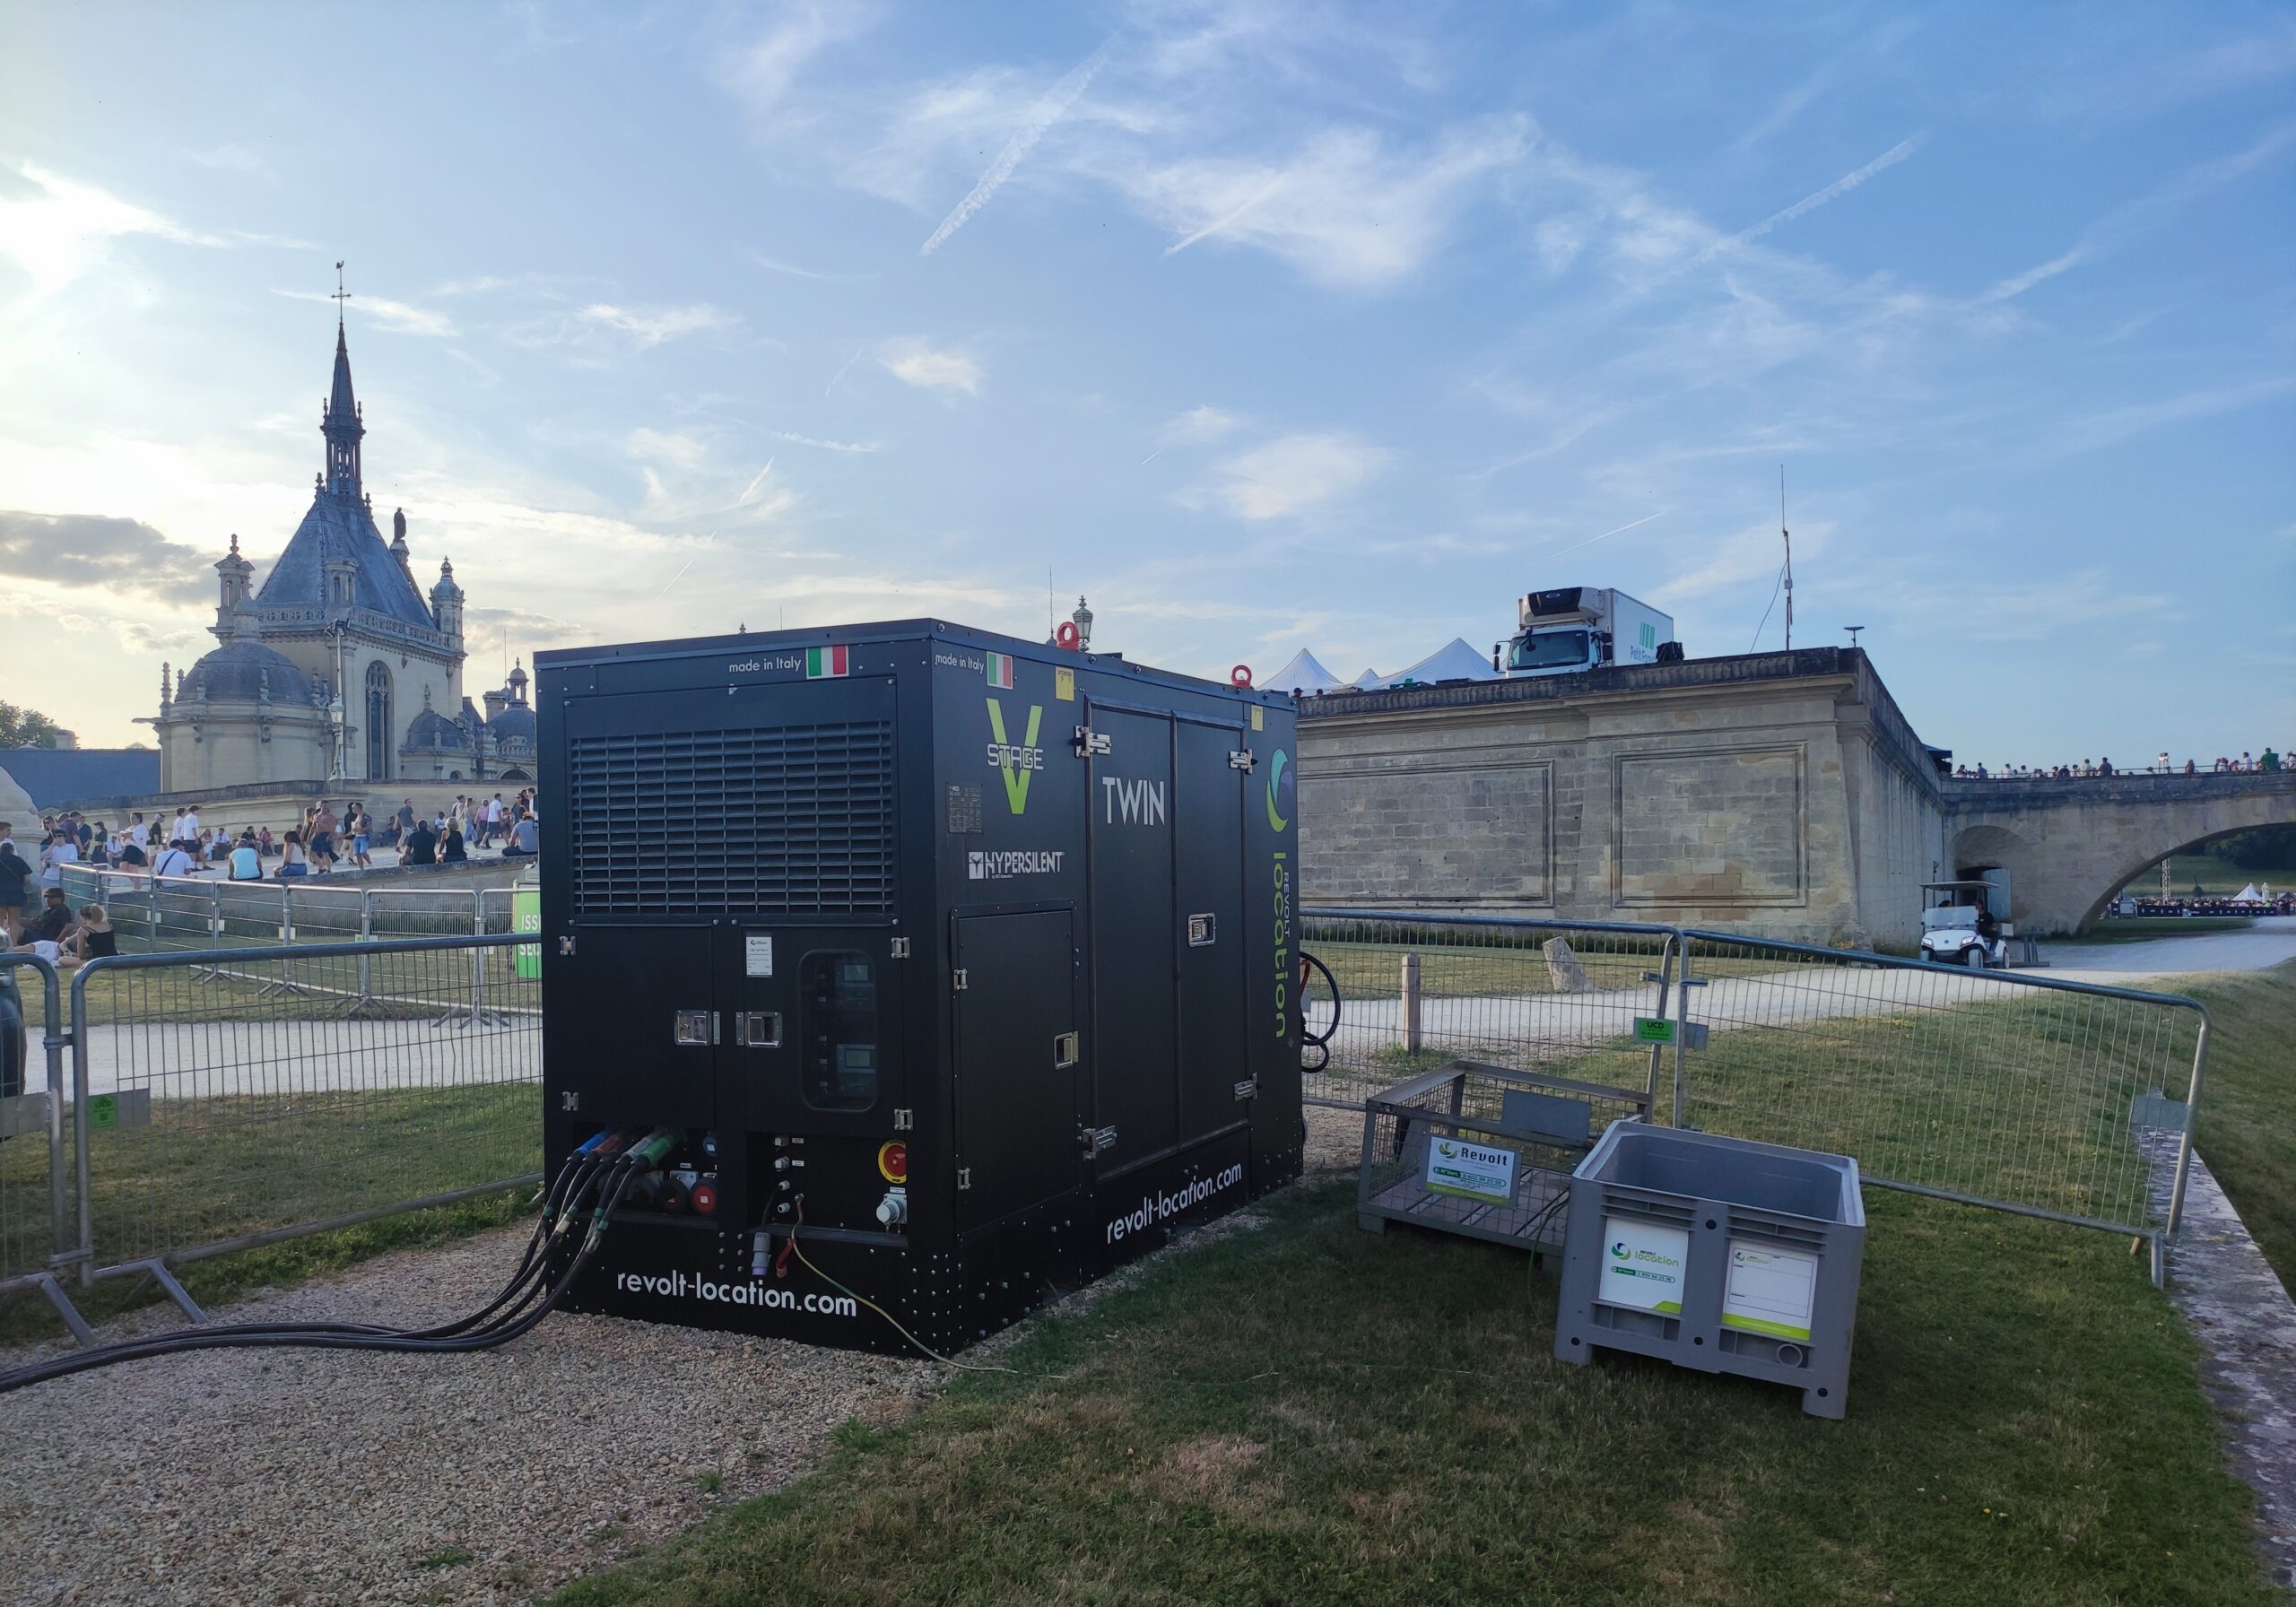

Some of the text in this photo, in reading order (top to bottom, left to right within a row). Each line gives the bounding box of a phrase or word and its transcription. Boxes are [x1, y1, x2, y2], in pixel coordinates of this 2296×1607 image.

[728, 656, 802, 673] made in Italy
[935, 653, 984, 674] made in Italy
[987, 743, 1044, 769] STAGE
[1102, 776, 1166, 826] TWIN
[985, 851, 1064, 879] HYPERSILENT
[1283, 871, 1292, 938] REVOLT
[1273, 852, 1289, 1038] location
[1461, 1147, 1508, 1167] Revolt
[1107, 1162, 1242, 1245] revolt-location.com
[1635, 1250, 1679, 1267] location
[617, 1270, 857, 1317] revolt-location.com
